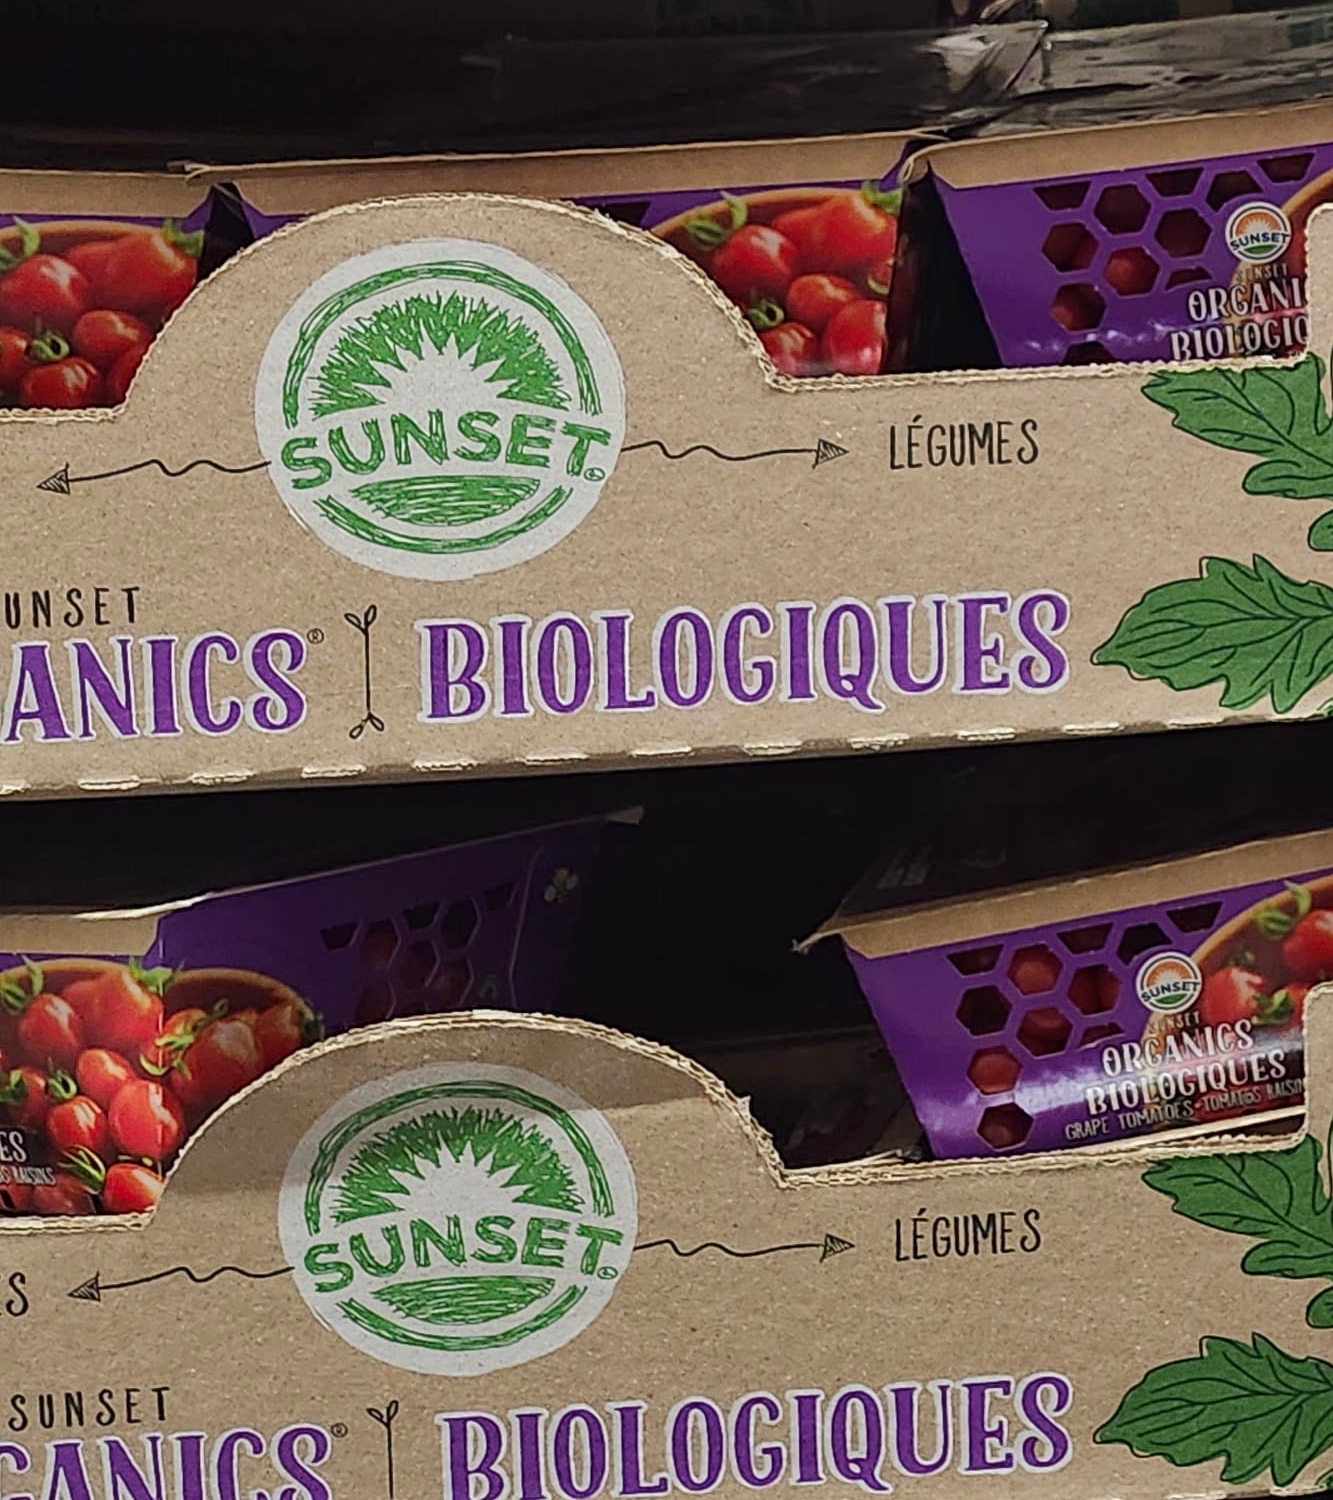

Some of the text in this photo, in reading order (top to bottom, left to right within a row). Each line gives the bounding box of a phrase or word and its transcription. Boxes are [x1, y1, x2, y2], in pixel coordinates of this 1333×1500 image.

[1229, 231, 1291, 251] SUNSET
[1188, 277, 1307, 322] ORGANI
[280, 408, 612, 490] SUNSET
[889, 414, 1039, 470] LÉGUMES
[419, 592, 1070, 722] BIOLOGIQUES
[1141, 977, 1202, 1003] SUNSET
[1101, 1019, 1255, 1078] ORGANICS
[1085, 1049, 1287, 1116] BIOLOGIQUES
[1065, 1116, 1110, 1141] GRAPE
[1118, 1100, 1194, 1131] TOMATOES
[304, 1212, 625, 1294] SUNSET
[895, 1207, 1042, 1262] LÉGUMES
[8, 1386, 171, 1432] SUNSET
[440, 1374, 1072, 1500] BIOLOGIQUES
